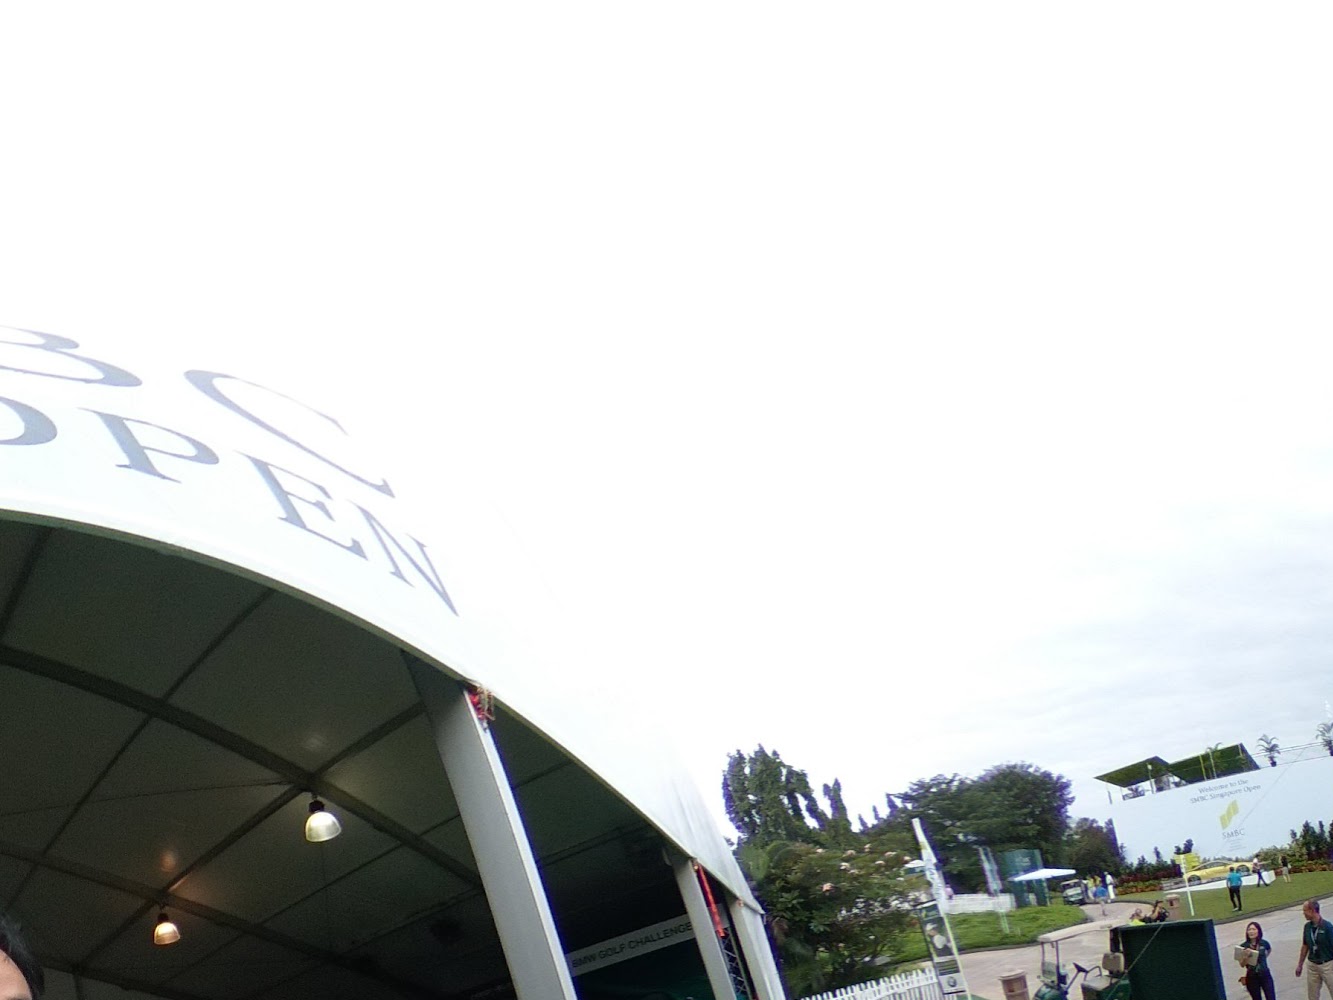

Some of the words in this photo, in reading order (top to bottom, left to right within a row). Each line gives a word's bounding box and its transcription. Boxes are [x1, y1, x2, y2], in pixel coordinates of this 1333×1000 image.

[1190, 794, 1209, 804] SMBC
[1210, 788, 1243, 799] Singapore
[1243, 784, 1261, 793] Open
[1198, 784, 1229, 794] Welcome
[1222, 828, 1245, 839] SMBC
[572, 954, 598, 968] BMW
[599, 943, 626, 959] GOLF
[628, 921, 693, 949] CHALLENGE
